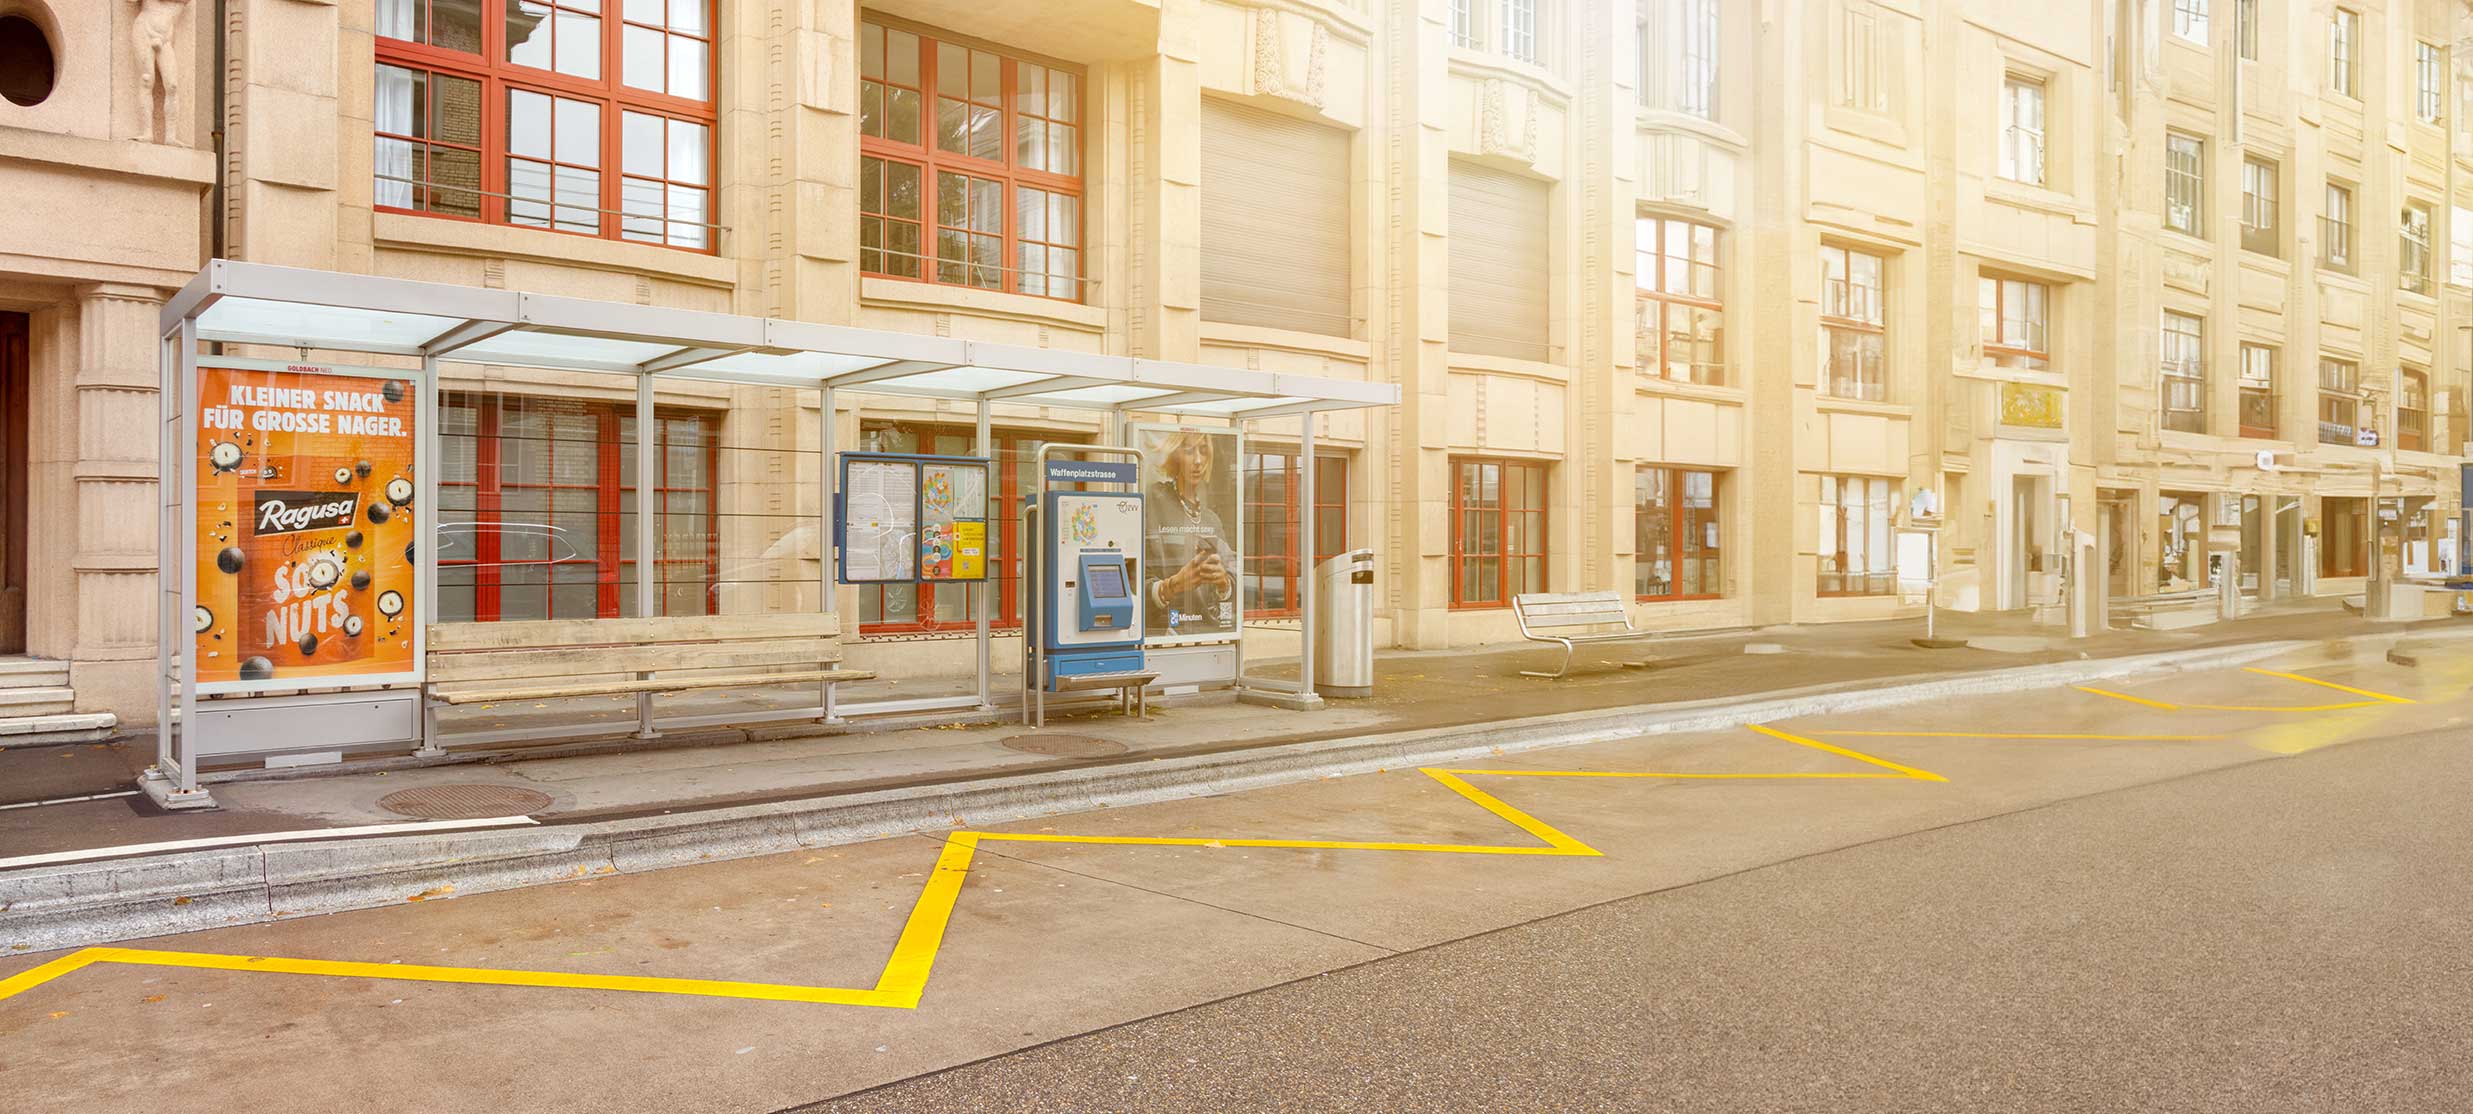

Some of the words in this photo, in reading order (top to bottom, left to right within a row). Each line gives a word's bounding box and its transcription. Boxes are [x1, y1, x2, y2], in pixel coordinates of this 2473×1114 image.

[288, 365, 319, 373] GOLDBACH
[231, 385, 316, 409] KLEINER
[323, 391, 385, 413] SNACK
[204, 405, 244, 430] FÜR
[252, 410, 331, 433] GROSSE
[338, 415, 407, 437] NAGER.
[1050, 468, 1116, 478] Waffenplatzstrasse
[259, 499, 354, 531] Ragusa
[283, 534, 336, 556] Classique
